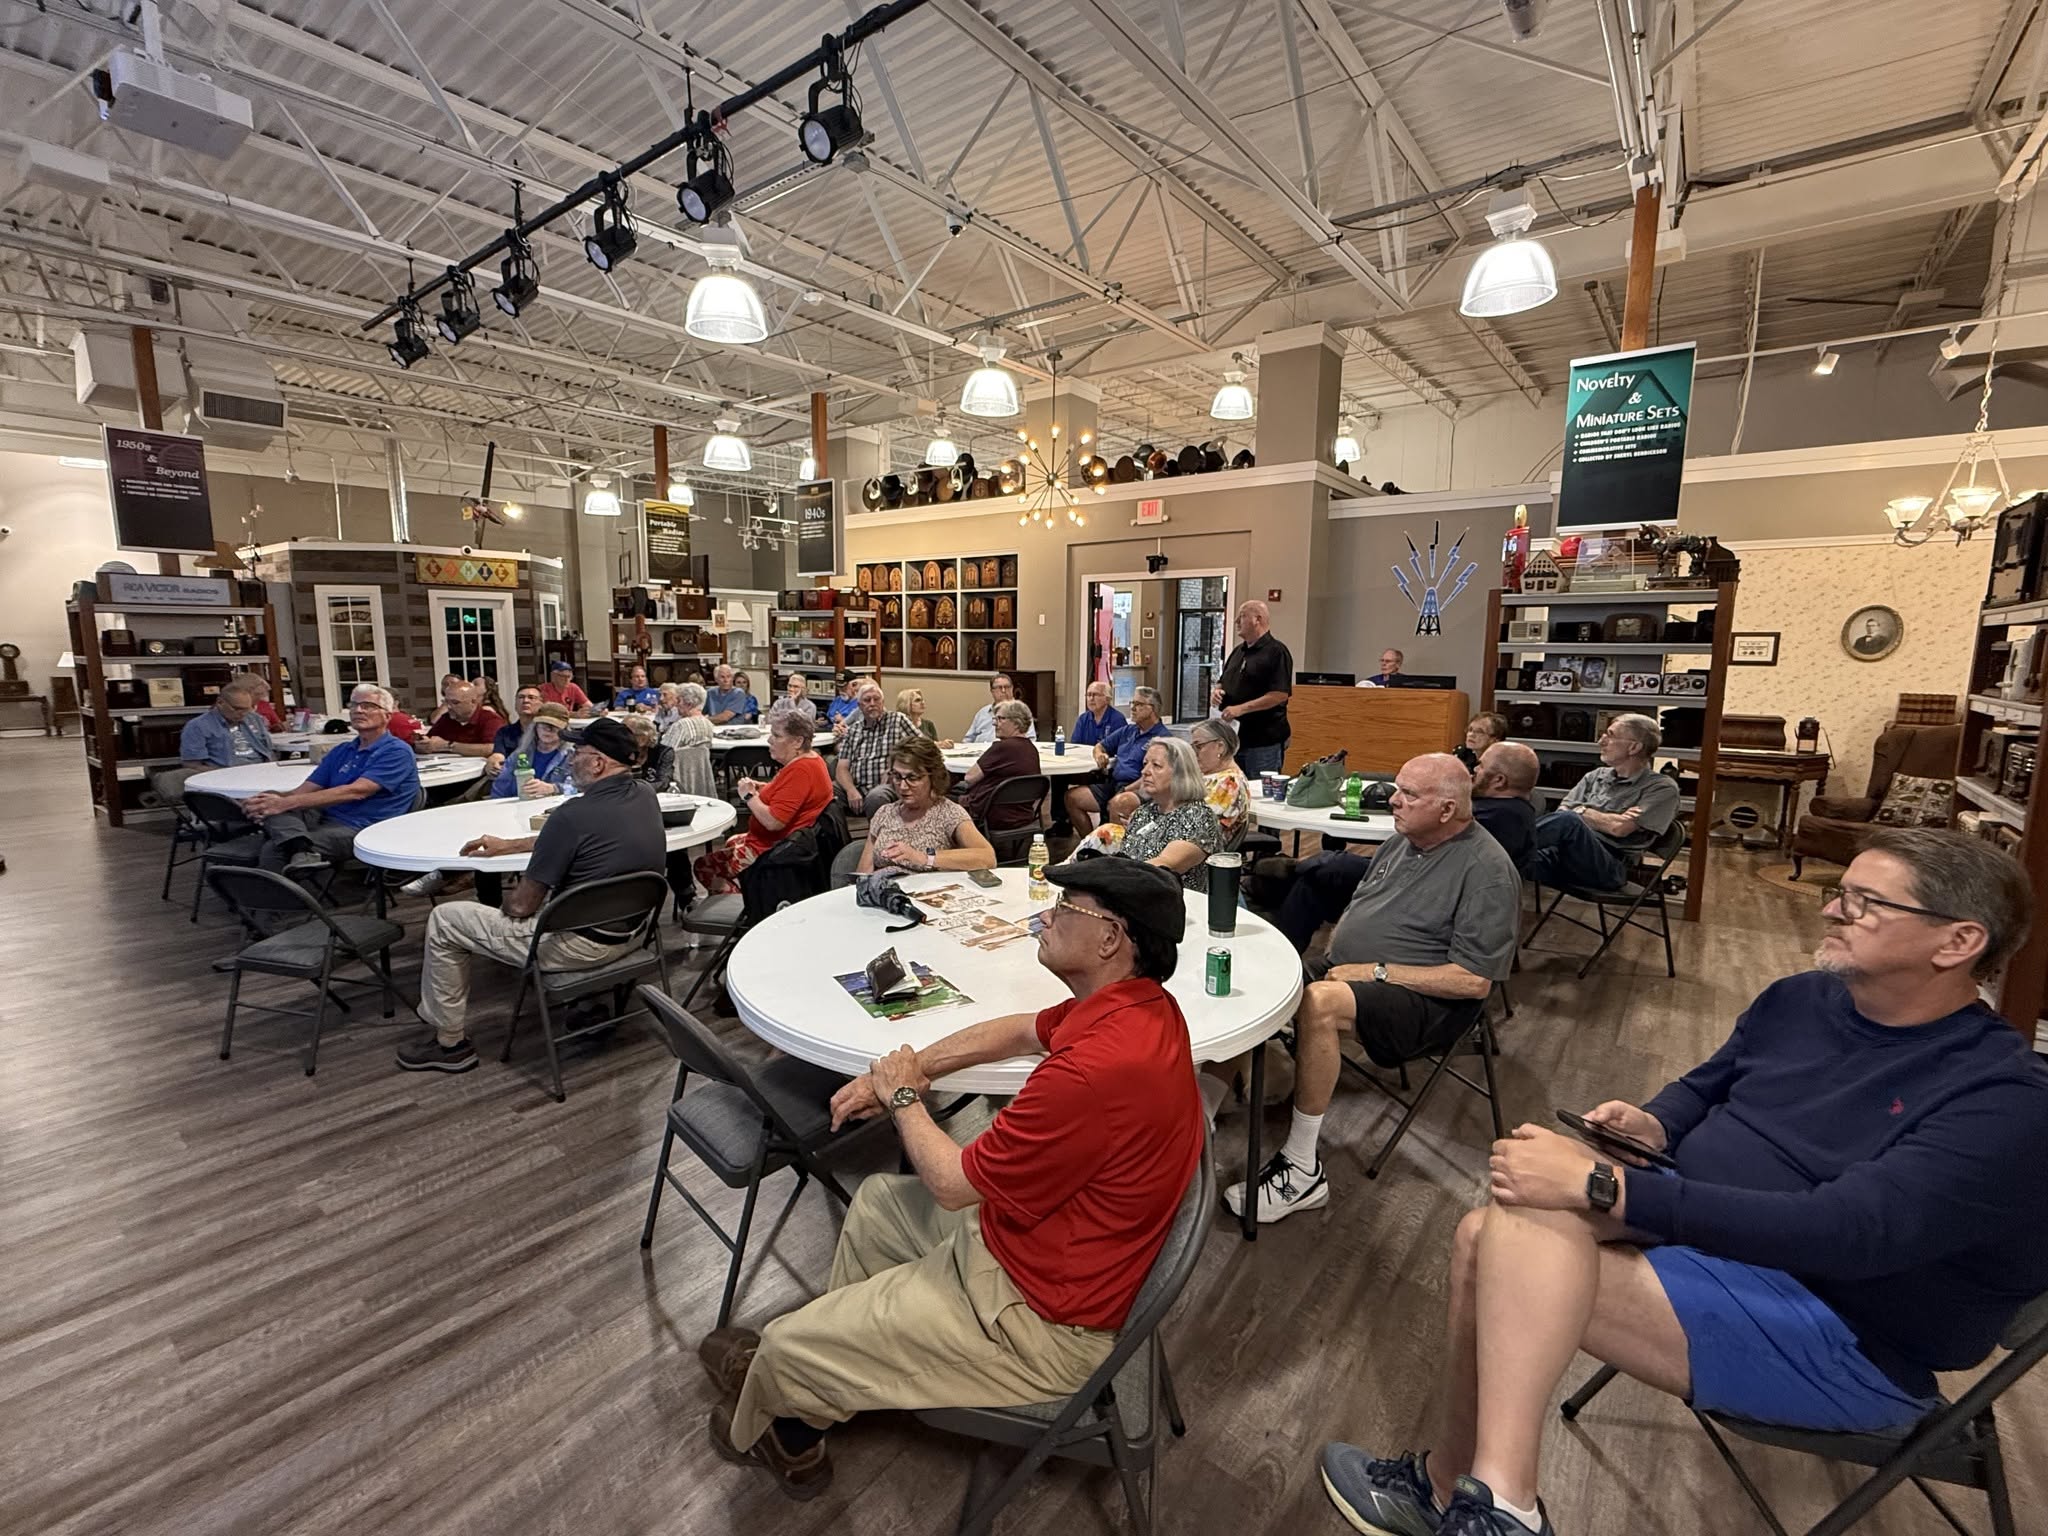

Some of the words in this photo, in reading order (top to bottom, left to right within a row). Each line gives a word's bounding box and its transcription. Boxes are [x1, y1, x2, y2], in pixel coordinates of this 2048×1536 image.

[1628, 392, 1642, 404] &
[116, 440, 152, 451] 1950s
[147, 454, 158, 463] &
[155, 466, 200, 479] Beyond
[805, 507, 826, 519] 1940s
[1141, 501, 1158, 517] EXIT
